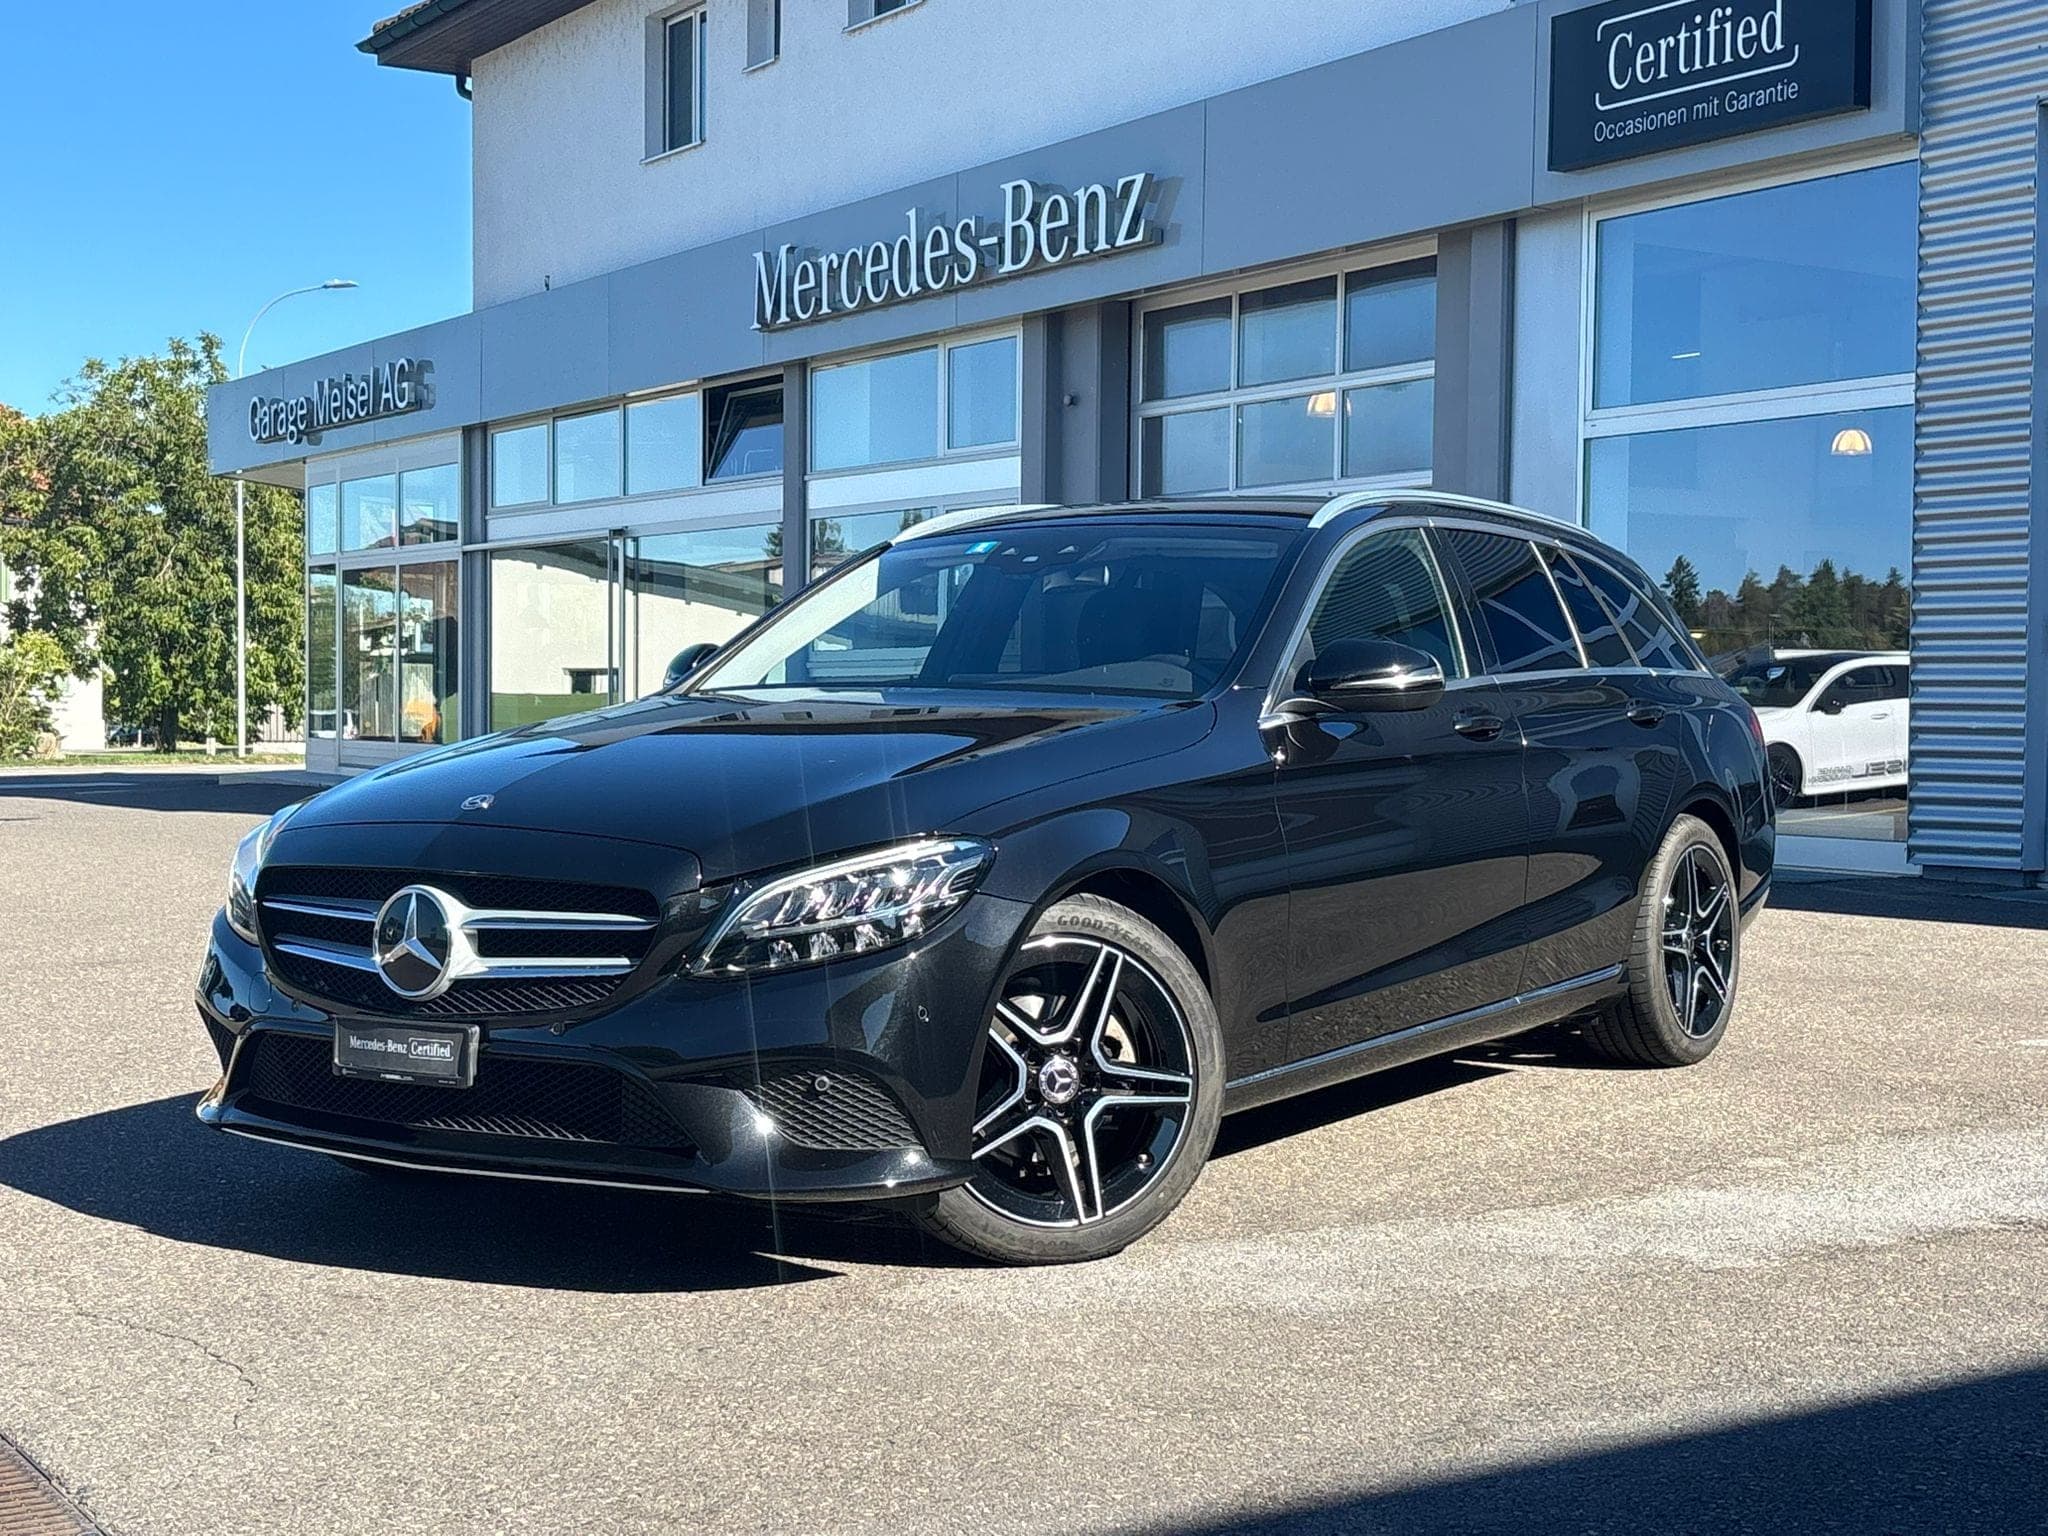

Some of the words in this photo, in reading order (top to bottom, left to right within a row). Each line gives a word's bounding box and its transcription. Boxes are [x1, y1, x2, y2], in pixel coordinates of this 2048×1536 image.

[1608, 0, 1785, 90] Certified
[1594, 106, 1687, 142] Occasionen
[1692, 96, 1720, 120] mit
[1725, 79, 1799, 113] Garantie
[749, 172, 1150, 331] Mercedes-Benz
[248, 395, 307, 445] Garage
[313, 366, 374, 427] Meisel
[379, 357, 409, 413] AG
[349, 1035, 408, 1054] Mercedes-Benz
[411, 1041, 451, 1057] Certified
